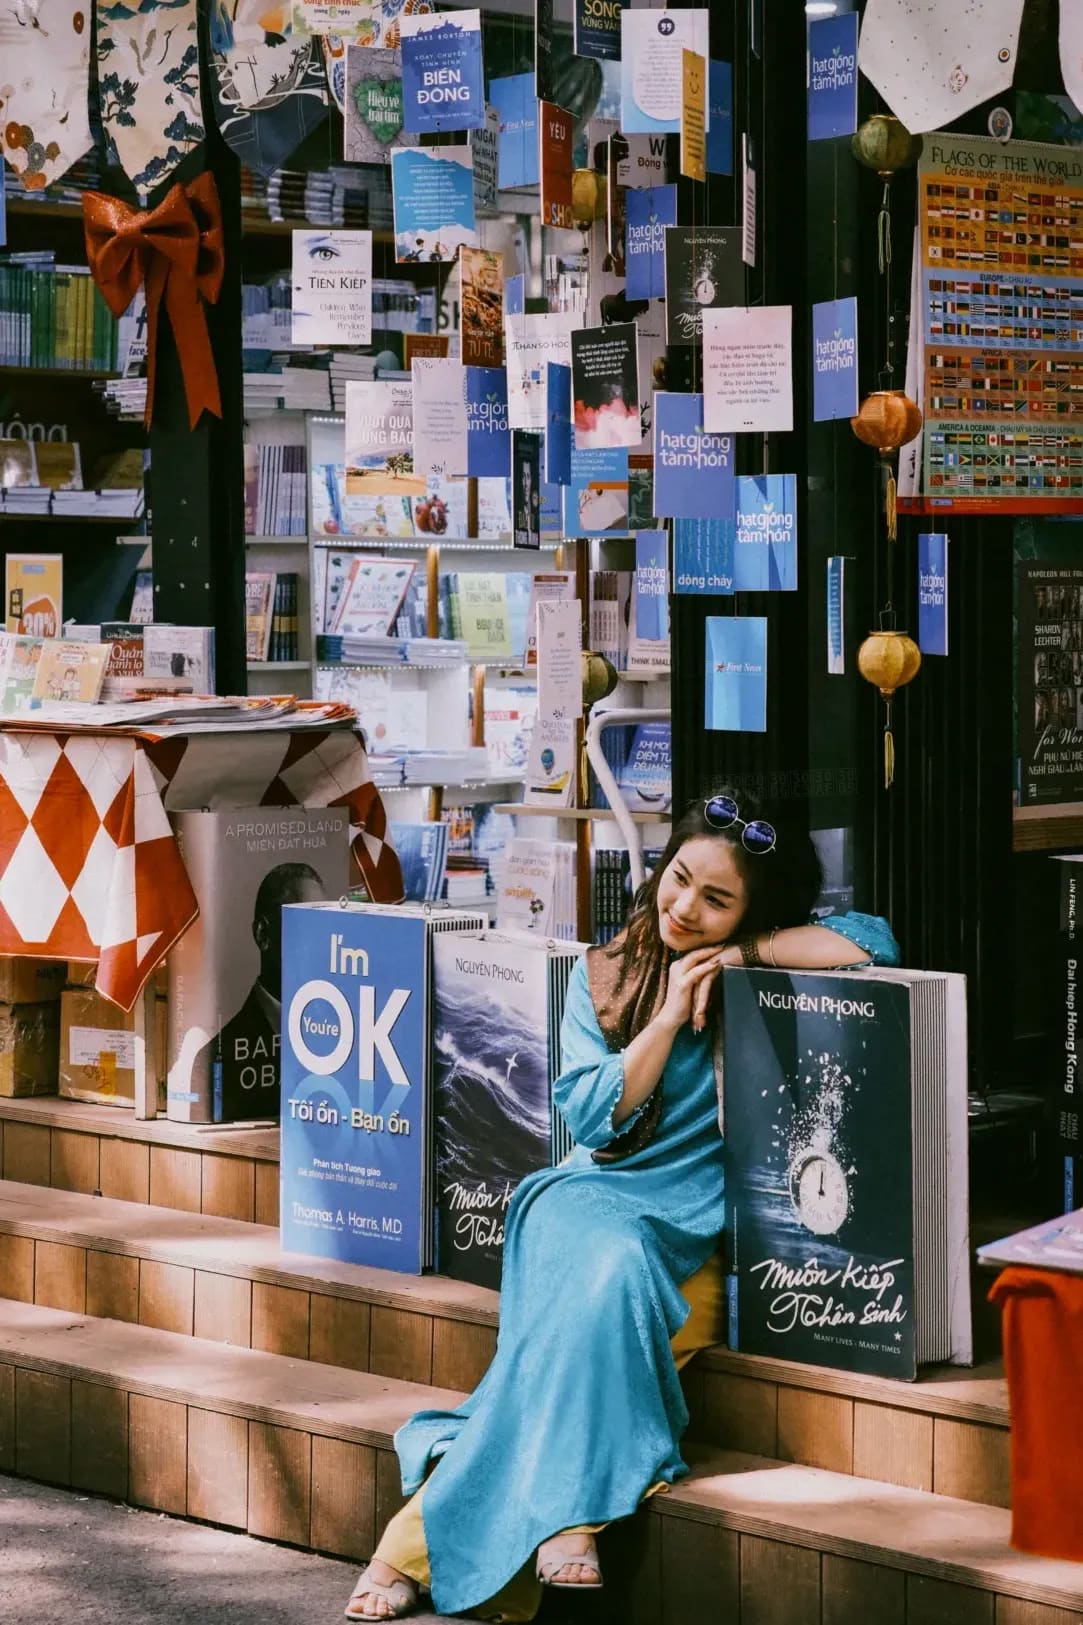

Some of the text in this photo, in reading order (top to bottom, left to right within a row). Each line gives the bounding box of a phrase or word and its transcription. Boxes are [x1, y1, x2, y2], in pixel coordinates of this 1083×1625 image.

[932, 147, 1082, 179] FLAGS OF THE WORLD
[938, 423, 963, 432] AMERICA
[970, 424, 995, 433] OCEANIA
[1027, 570, 1058, 578] NAPOLEON
[1034, 624, 1061, 635] SHARON
[1034, 636, 1062, 646] LECHTER
[631, 657, 670, 666] THINK SMAL
[1033, 726, 1083, 760] for Wo
[225, 819, 343, 837] A PROMISED LAND
[1069, 878, 1077, 892] LIN
[330, 933, 369, 977] I'm
[492, 963, 525, 984] PHONG
[821, 995, 875, 1018] PHONG
[288, 979, 412, 1088] OK
[303, 1016, 339, 1037] You're
[288, 1099, 313, 1121] Tôi
[317, 1102, 338, 1125] ổn
[351, 1108, 384, 1135] Bạn
[388, 1110, 410, 1136] ổn
[367, 1167, 381, 1177] giao
[444, 1182, 500, 1210] Muôn
[293, 1202, 333, 1222] Thomas
[336, 1209, 345, 1225] A.
[454, 1212, 506, 1251] Nhâ
[750, 1256, 904, 1301] Muôn Kiếp
[858, 1294, 907, 1326] Sinh
[814, 1331, 901, 1354] MANY LIVES MANY TIMES
